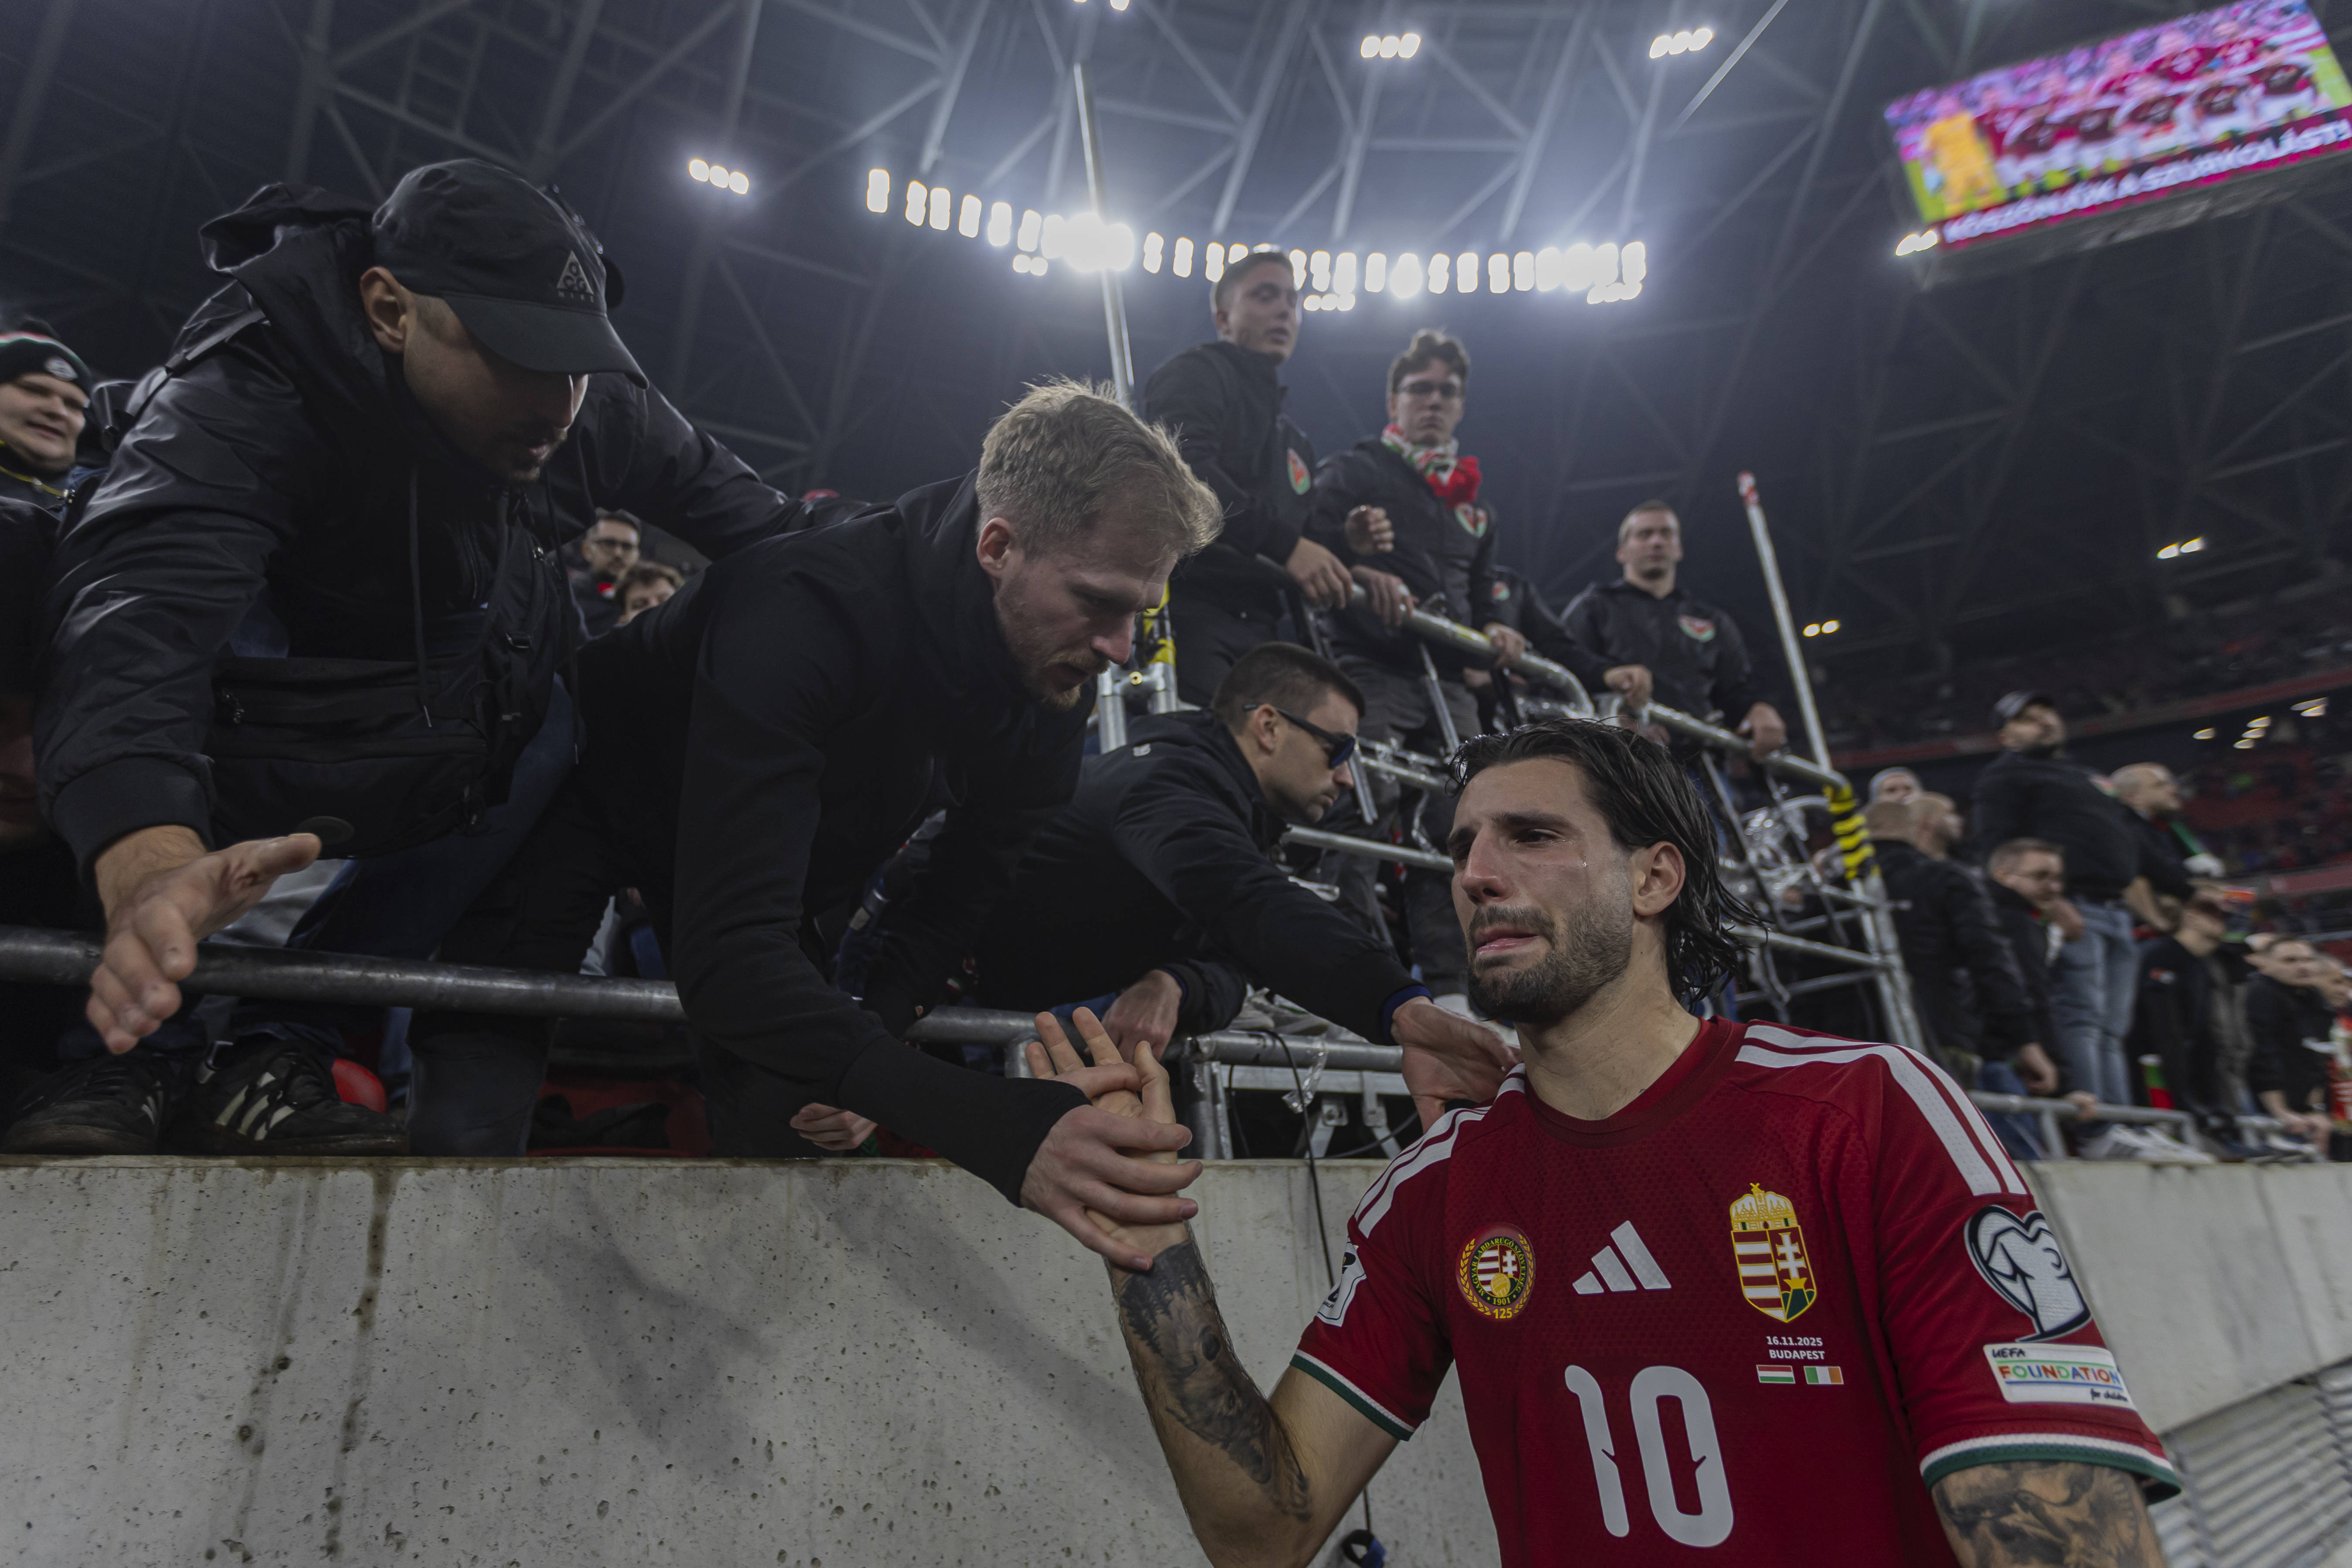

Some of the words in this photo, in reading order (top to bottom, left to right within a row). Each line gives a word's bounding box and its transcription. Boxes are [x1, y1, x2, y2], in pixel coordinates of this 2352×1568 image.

[1474, 1237, 1514, 1260] LABDARÚGÓ
[1471, 1261, 1485, 1296] MAGYAR
[1493, 1308, 1513, 1319] 125
[1766, 1336, 1823, 1346] 16.11.2025
[1769, 1349, 1825, 1360] BUDAPEST
[1998, 1365, 2120, 1384] FOUNDATION
[1565, 1365, 1733, 1548] 10
